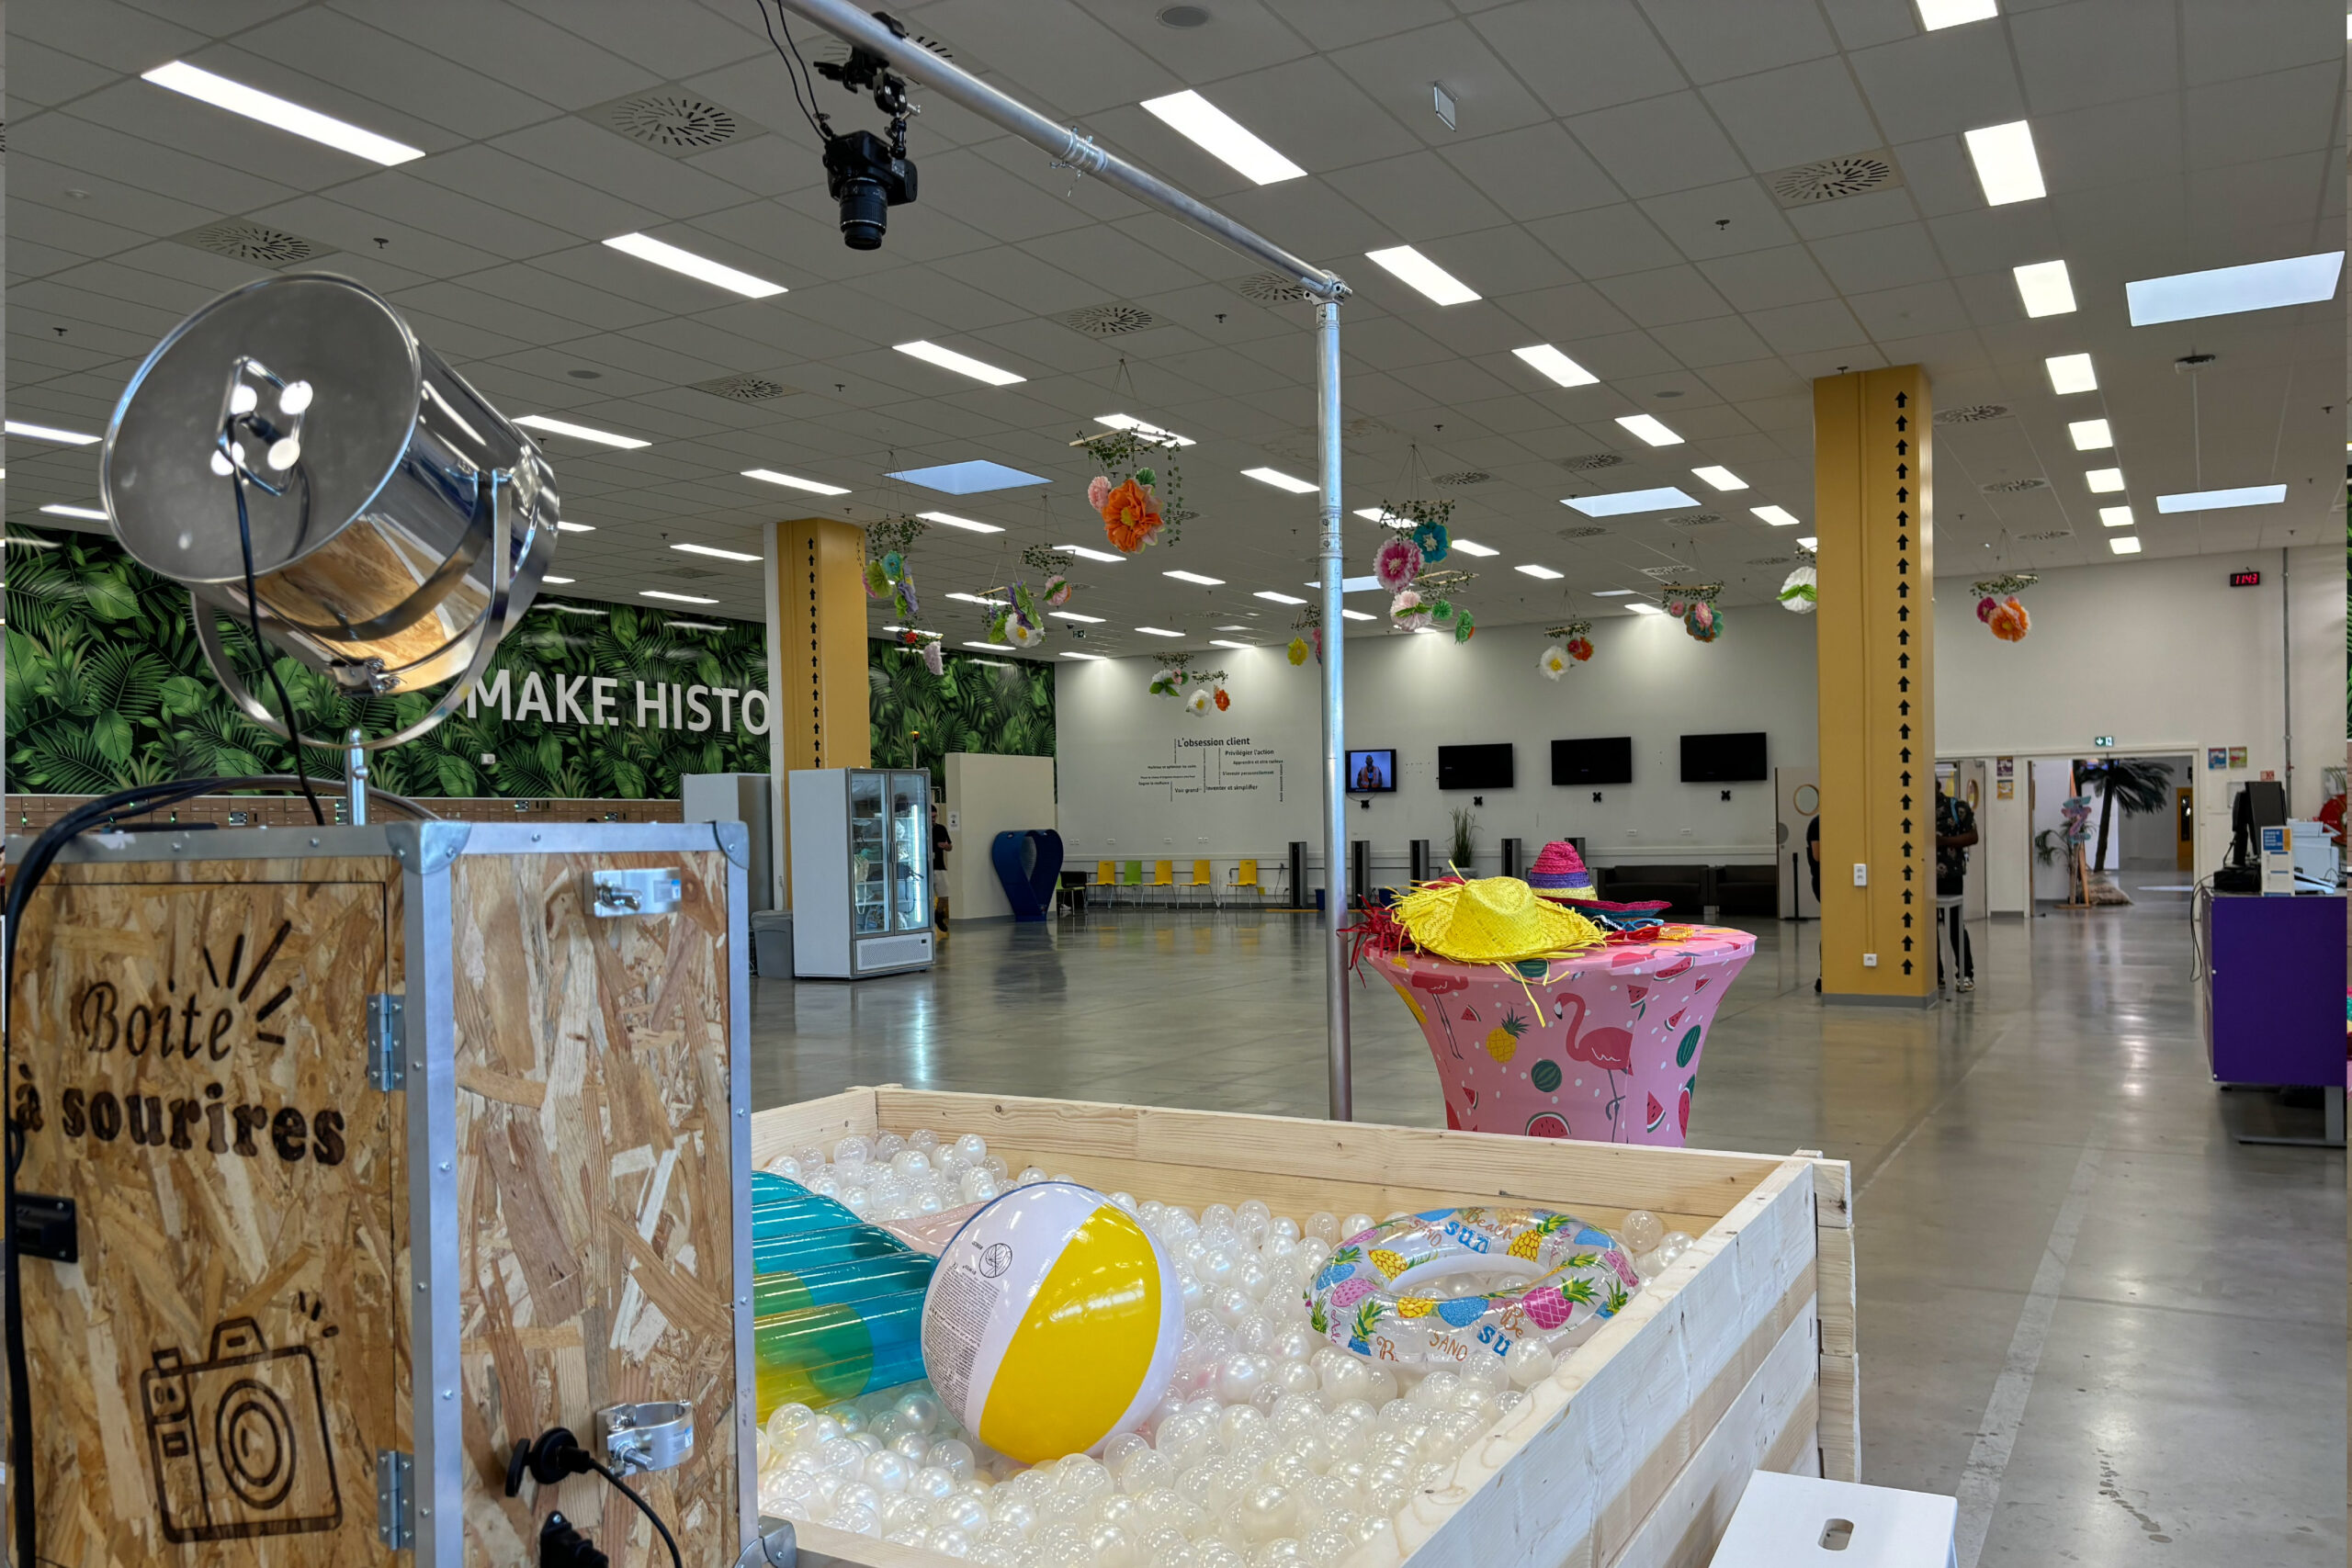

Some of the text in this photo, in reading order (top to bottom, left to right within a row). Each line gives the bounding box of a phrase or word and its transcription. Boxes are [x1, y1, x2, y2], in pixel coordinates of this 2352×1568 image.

[467, 669, 619, 727] MAKE
[1177, 737, 1250, 748] L'obsession client
[16, 1063, 345, 1167] à sourires
[1462, 1206, 1517, 1241] Beach
[1429, 1331, 1468, 1361] SAND
